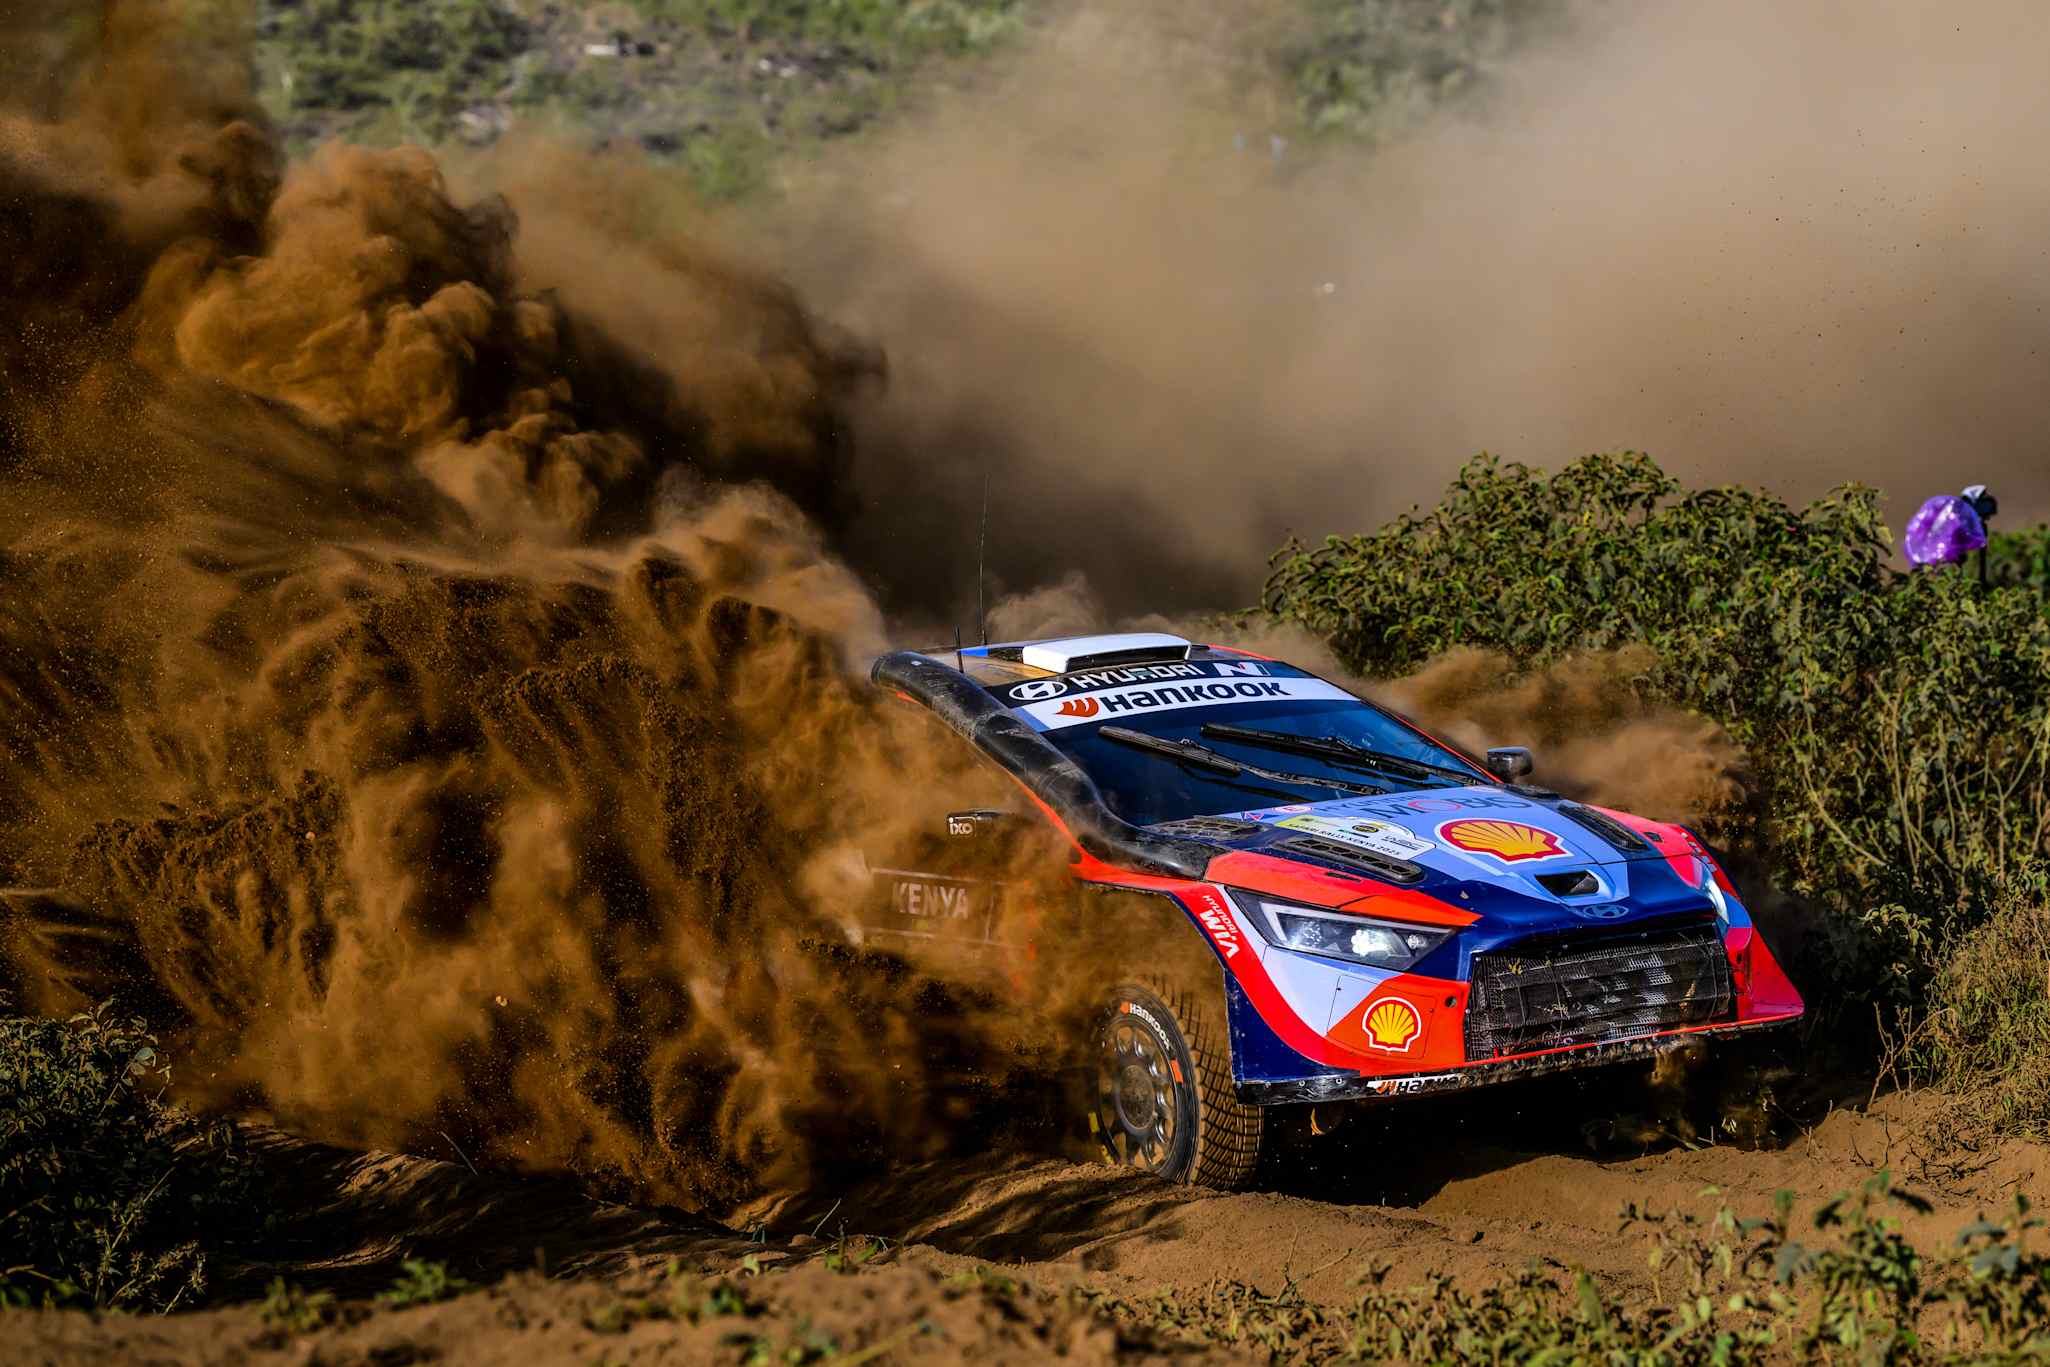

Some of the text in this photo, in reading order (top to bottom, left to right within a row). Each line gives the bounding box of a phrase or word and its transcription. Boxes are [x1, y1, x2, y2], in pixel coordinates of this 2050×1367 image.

[1069, 664, 1207, 688] HYUNDAI
[1360, 797, 1532, 818] MOBIS
[893, 881, 969, 920] KENYA
